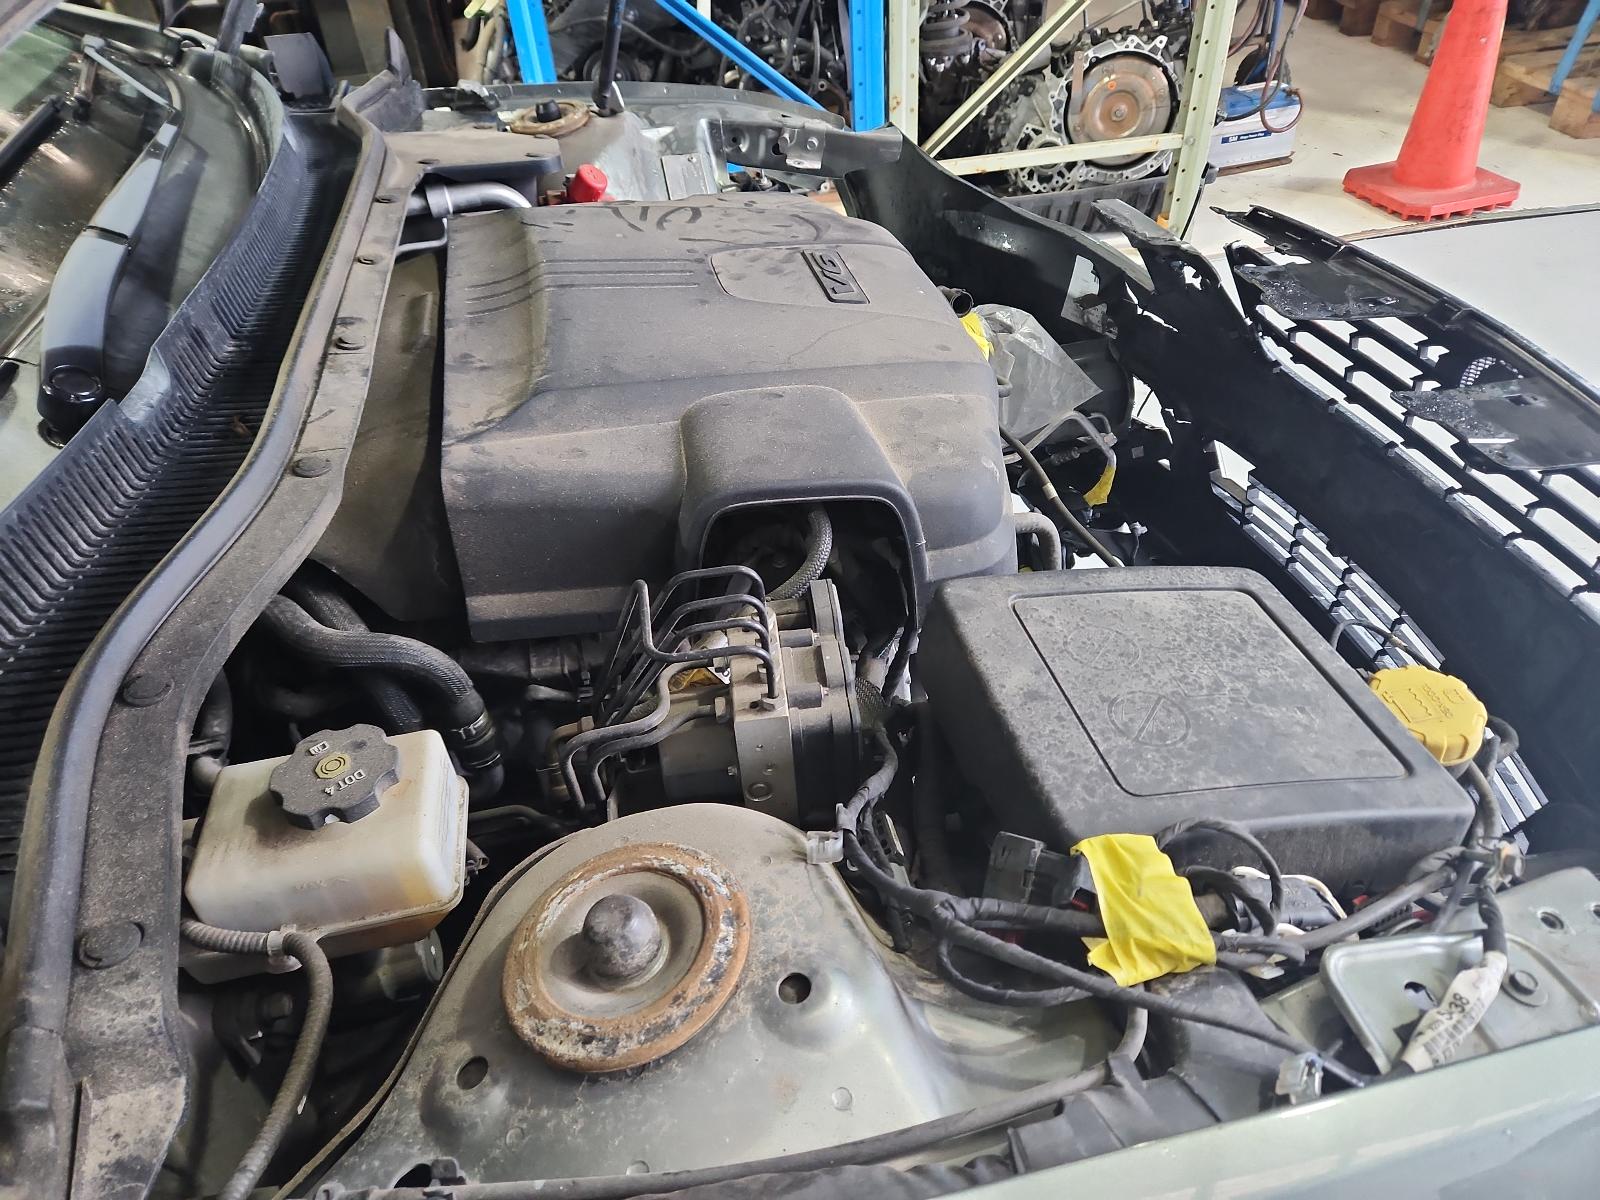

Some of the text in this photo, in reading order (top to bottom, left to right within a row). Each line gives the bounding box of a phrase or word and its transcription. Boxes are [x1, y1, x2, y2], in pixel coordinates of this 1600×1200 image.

[807, 251, 856, 296] V6
[324, 768, 367, 797] DOT 4
